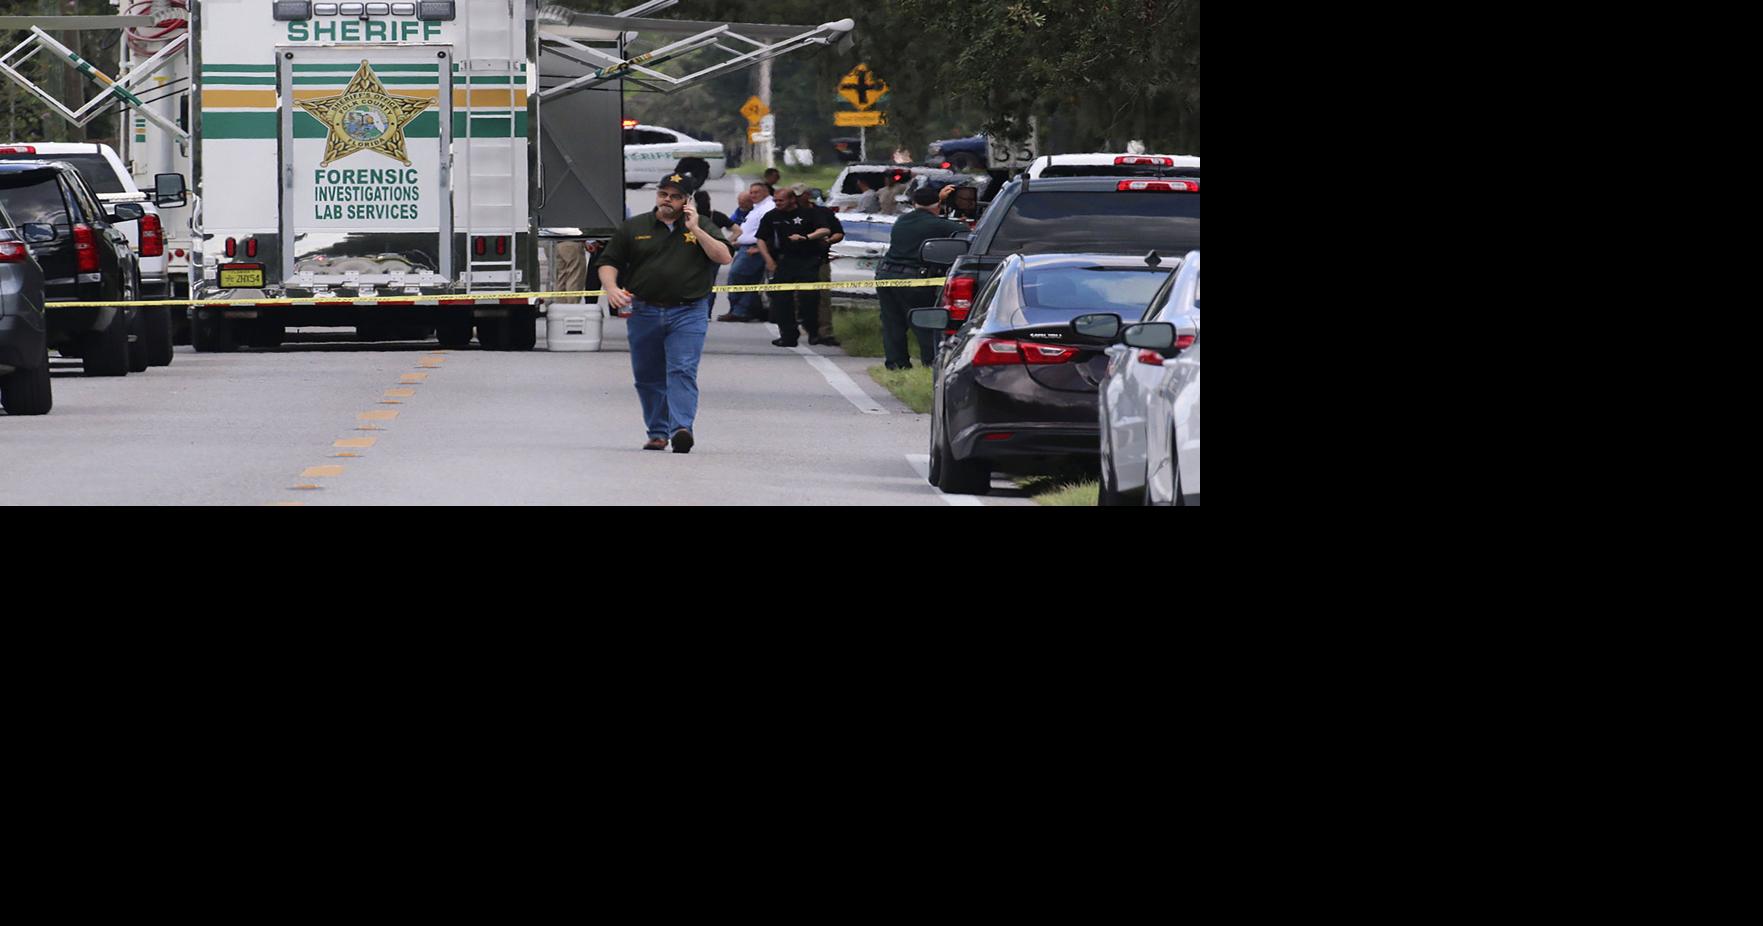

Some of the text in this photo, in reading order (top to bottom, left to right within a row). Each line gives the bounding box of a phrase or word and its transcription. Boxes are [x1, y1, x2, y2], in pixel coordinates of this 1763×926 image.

[287, 20, 442, 41] SHERIFF
[331, 92, 399, 111] SHERIFF'S OFFICE
[338, 99, 393, 115] POLK COUNTY
[347, 138, 385, 147] FLORIDA
[315, 168, 418, 185] FORENSIC
[315, 186, 420, 201] INVESTIGATIONS
[315, 204, 418, 220] LAB SERVICES
